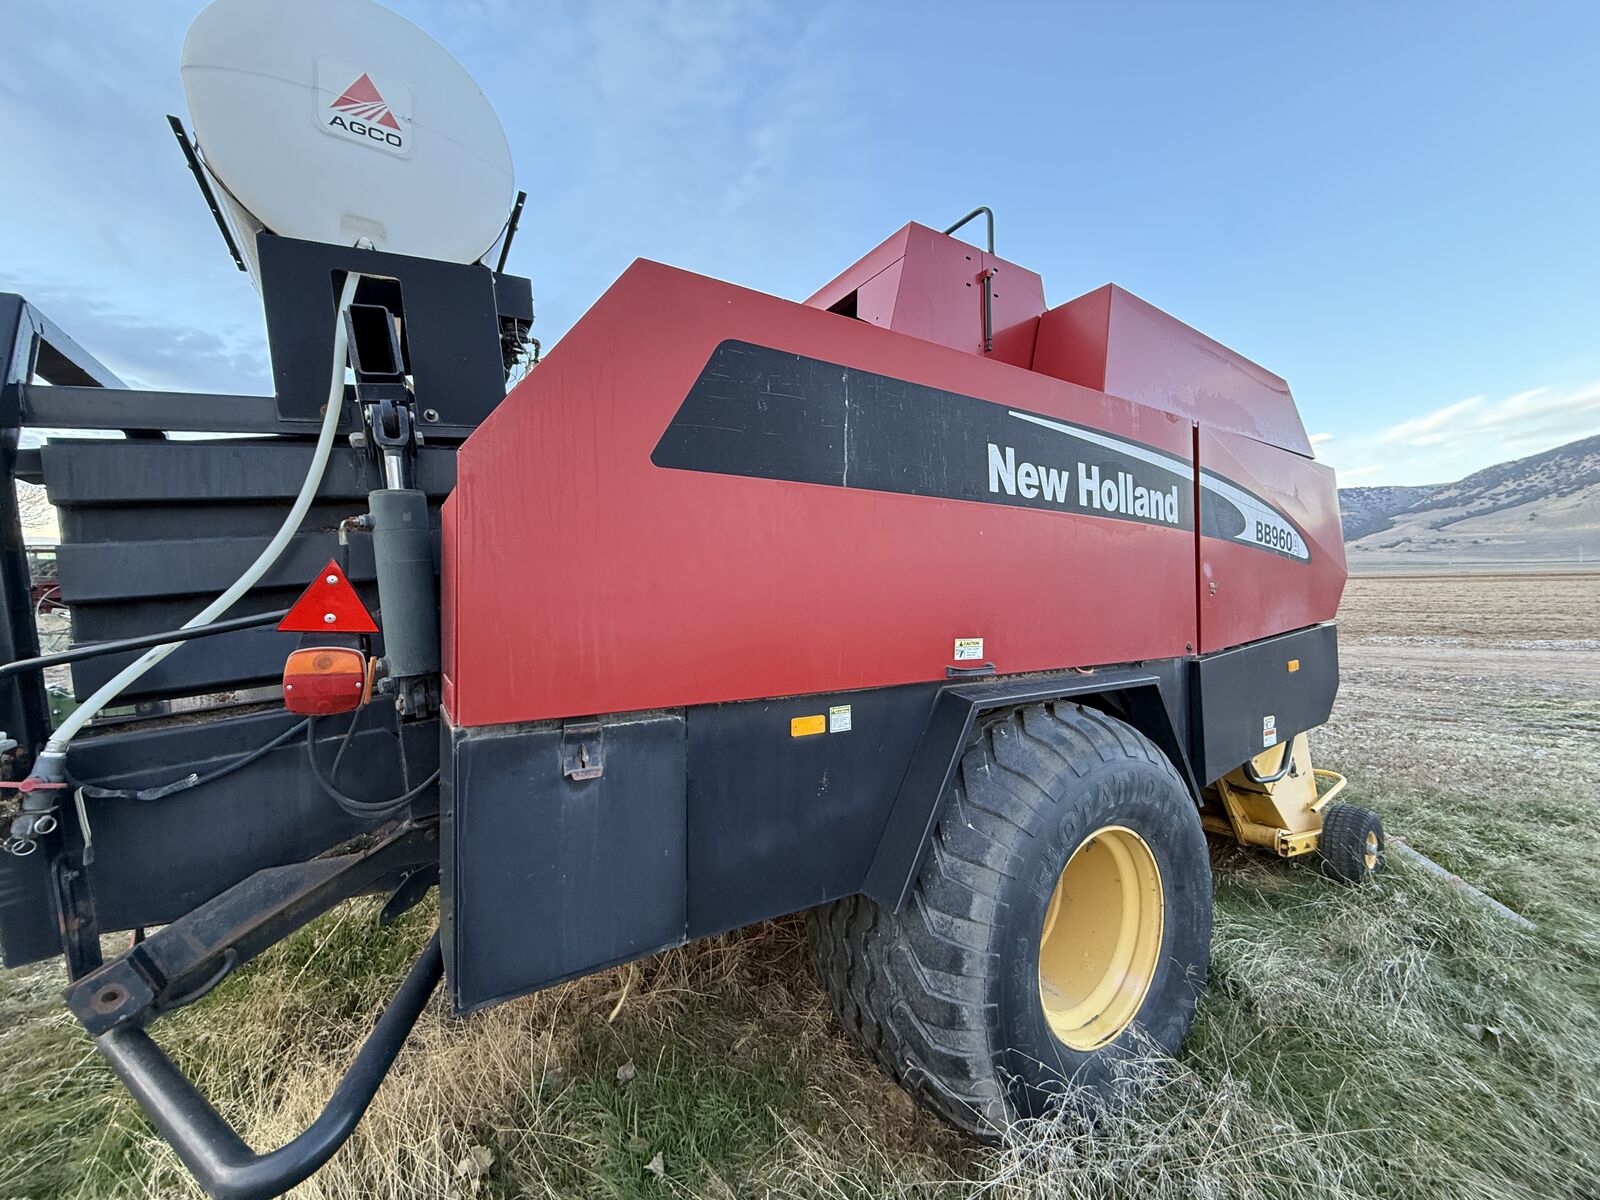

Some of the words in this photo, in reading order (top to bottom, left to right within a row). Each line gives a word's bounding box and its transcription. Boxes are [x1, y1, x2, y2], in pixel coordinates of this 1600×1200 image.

[329, 115, 402, 147] AGCO
[987, 443, 1069, 503] New
[1077, 461, 1179, 525] Holland
